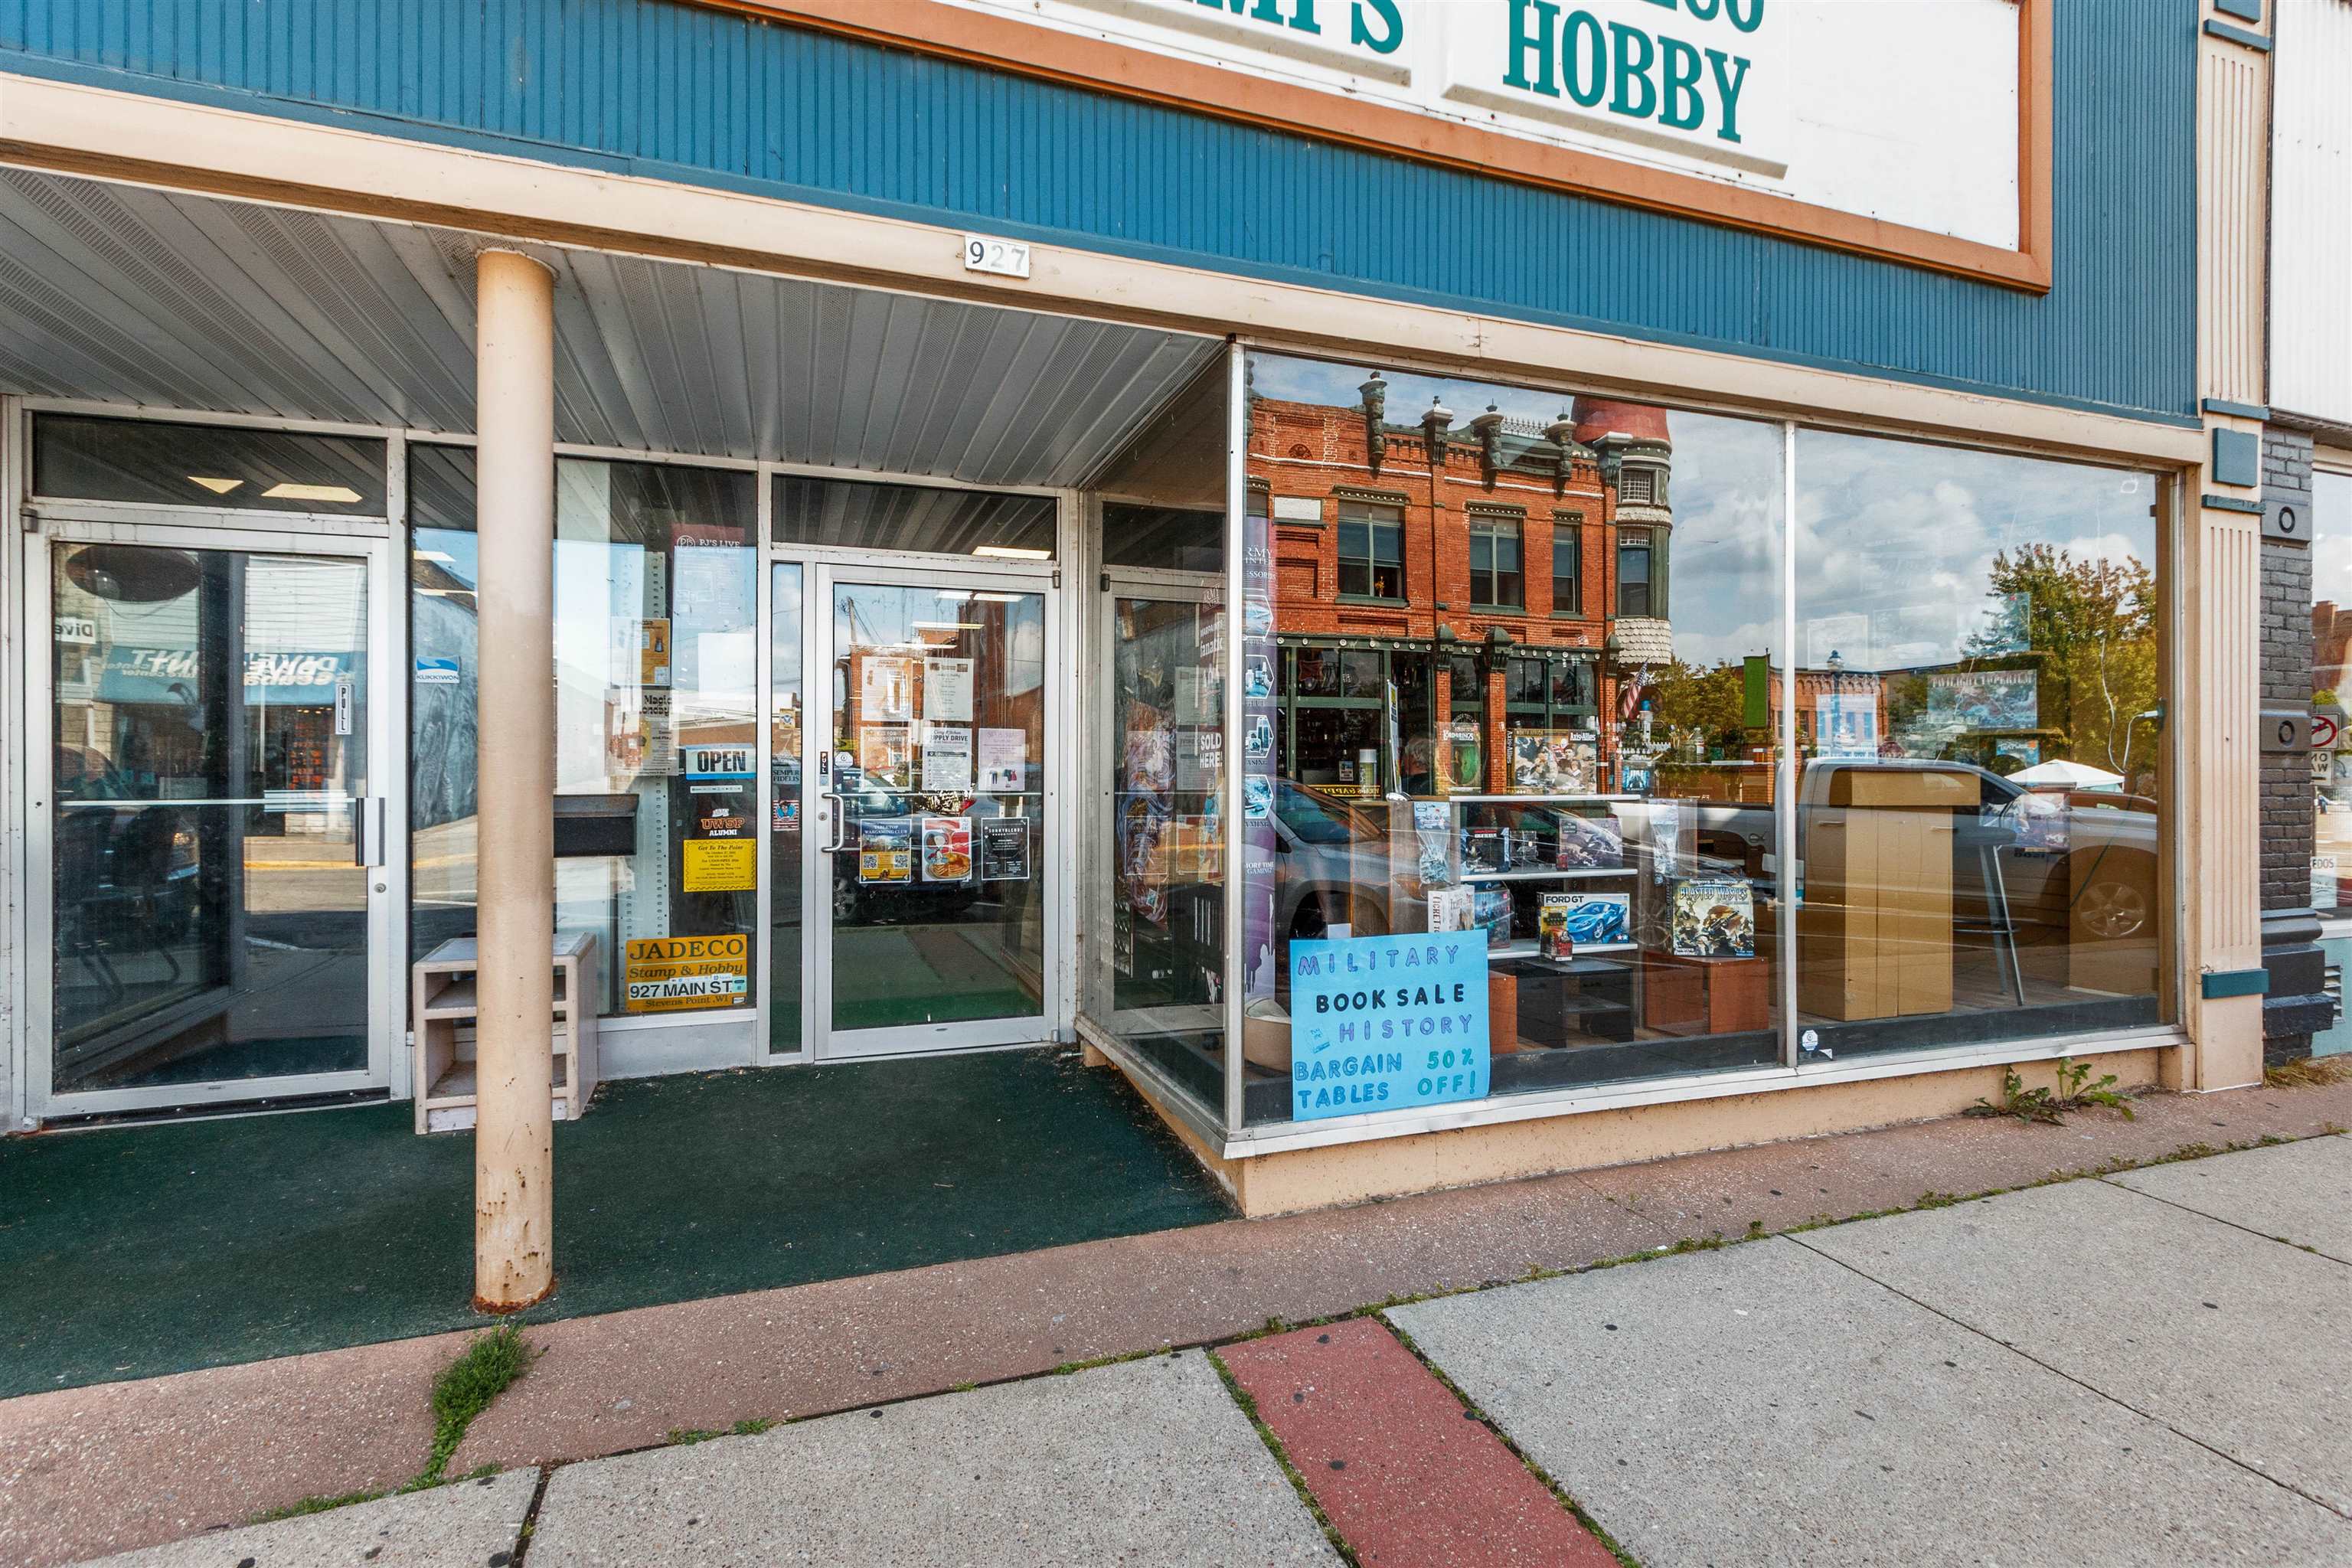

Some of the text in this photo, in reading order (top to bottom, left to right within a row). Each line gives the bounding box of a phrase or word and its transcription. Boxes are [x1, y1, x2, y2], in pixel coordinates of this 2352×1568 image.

[1503, 0, 1751, 144] HOBBY
[970, 241, 1026, 273] 927
[1247, 547, 1275, 559] RMY
[644, 694, 673, 707] Magic
[639, 707, 670, 717] onday
[1200, 732, 1222, 751] SOLD
[697, 750, 746, 773] OPEN
[1200, 751, 1223, 769] HERE!
[701, 817, 745, 829] UWSP
[1679, 887, 1747, 901] BLASTED WASTES
[1432, 896, 1441, 925] TICKET
[629, 938, 743, 960] JADECO
[1298, 945, 1459, 975] MILITARY
[629, 963, 743, 981] Stamp & Hobby
[630, 985, 660, 998] 927
[664, 982, 705, 997] MAIN
[710, 980, 733, 994] ST.
[1316, 984, 1464, 1013] BOOK SALE
[645, 998, 683, 1008] Stevens
[686, 996, 710, 1005] Point
[1340, 1014, 1472, 1043] HISTORY
[1294, 1048, 1474, 1081] BARGAIN 50%
[1298, 1071, 1476, 1109] TABLES OFF!
